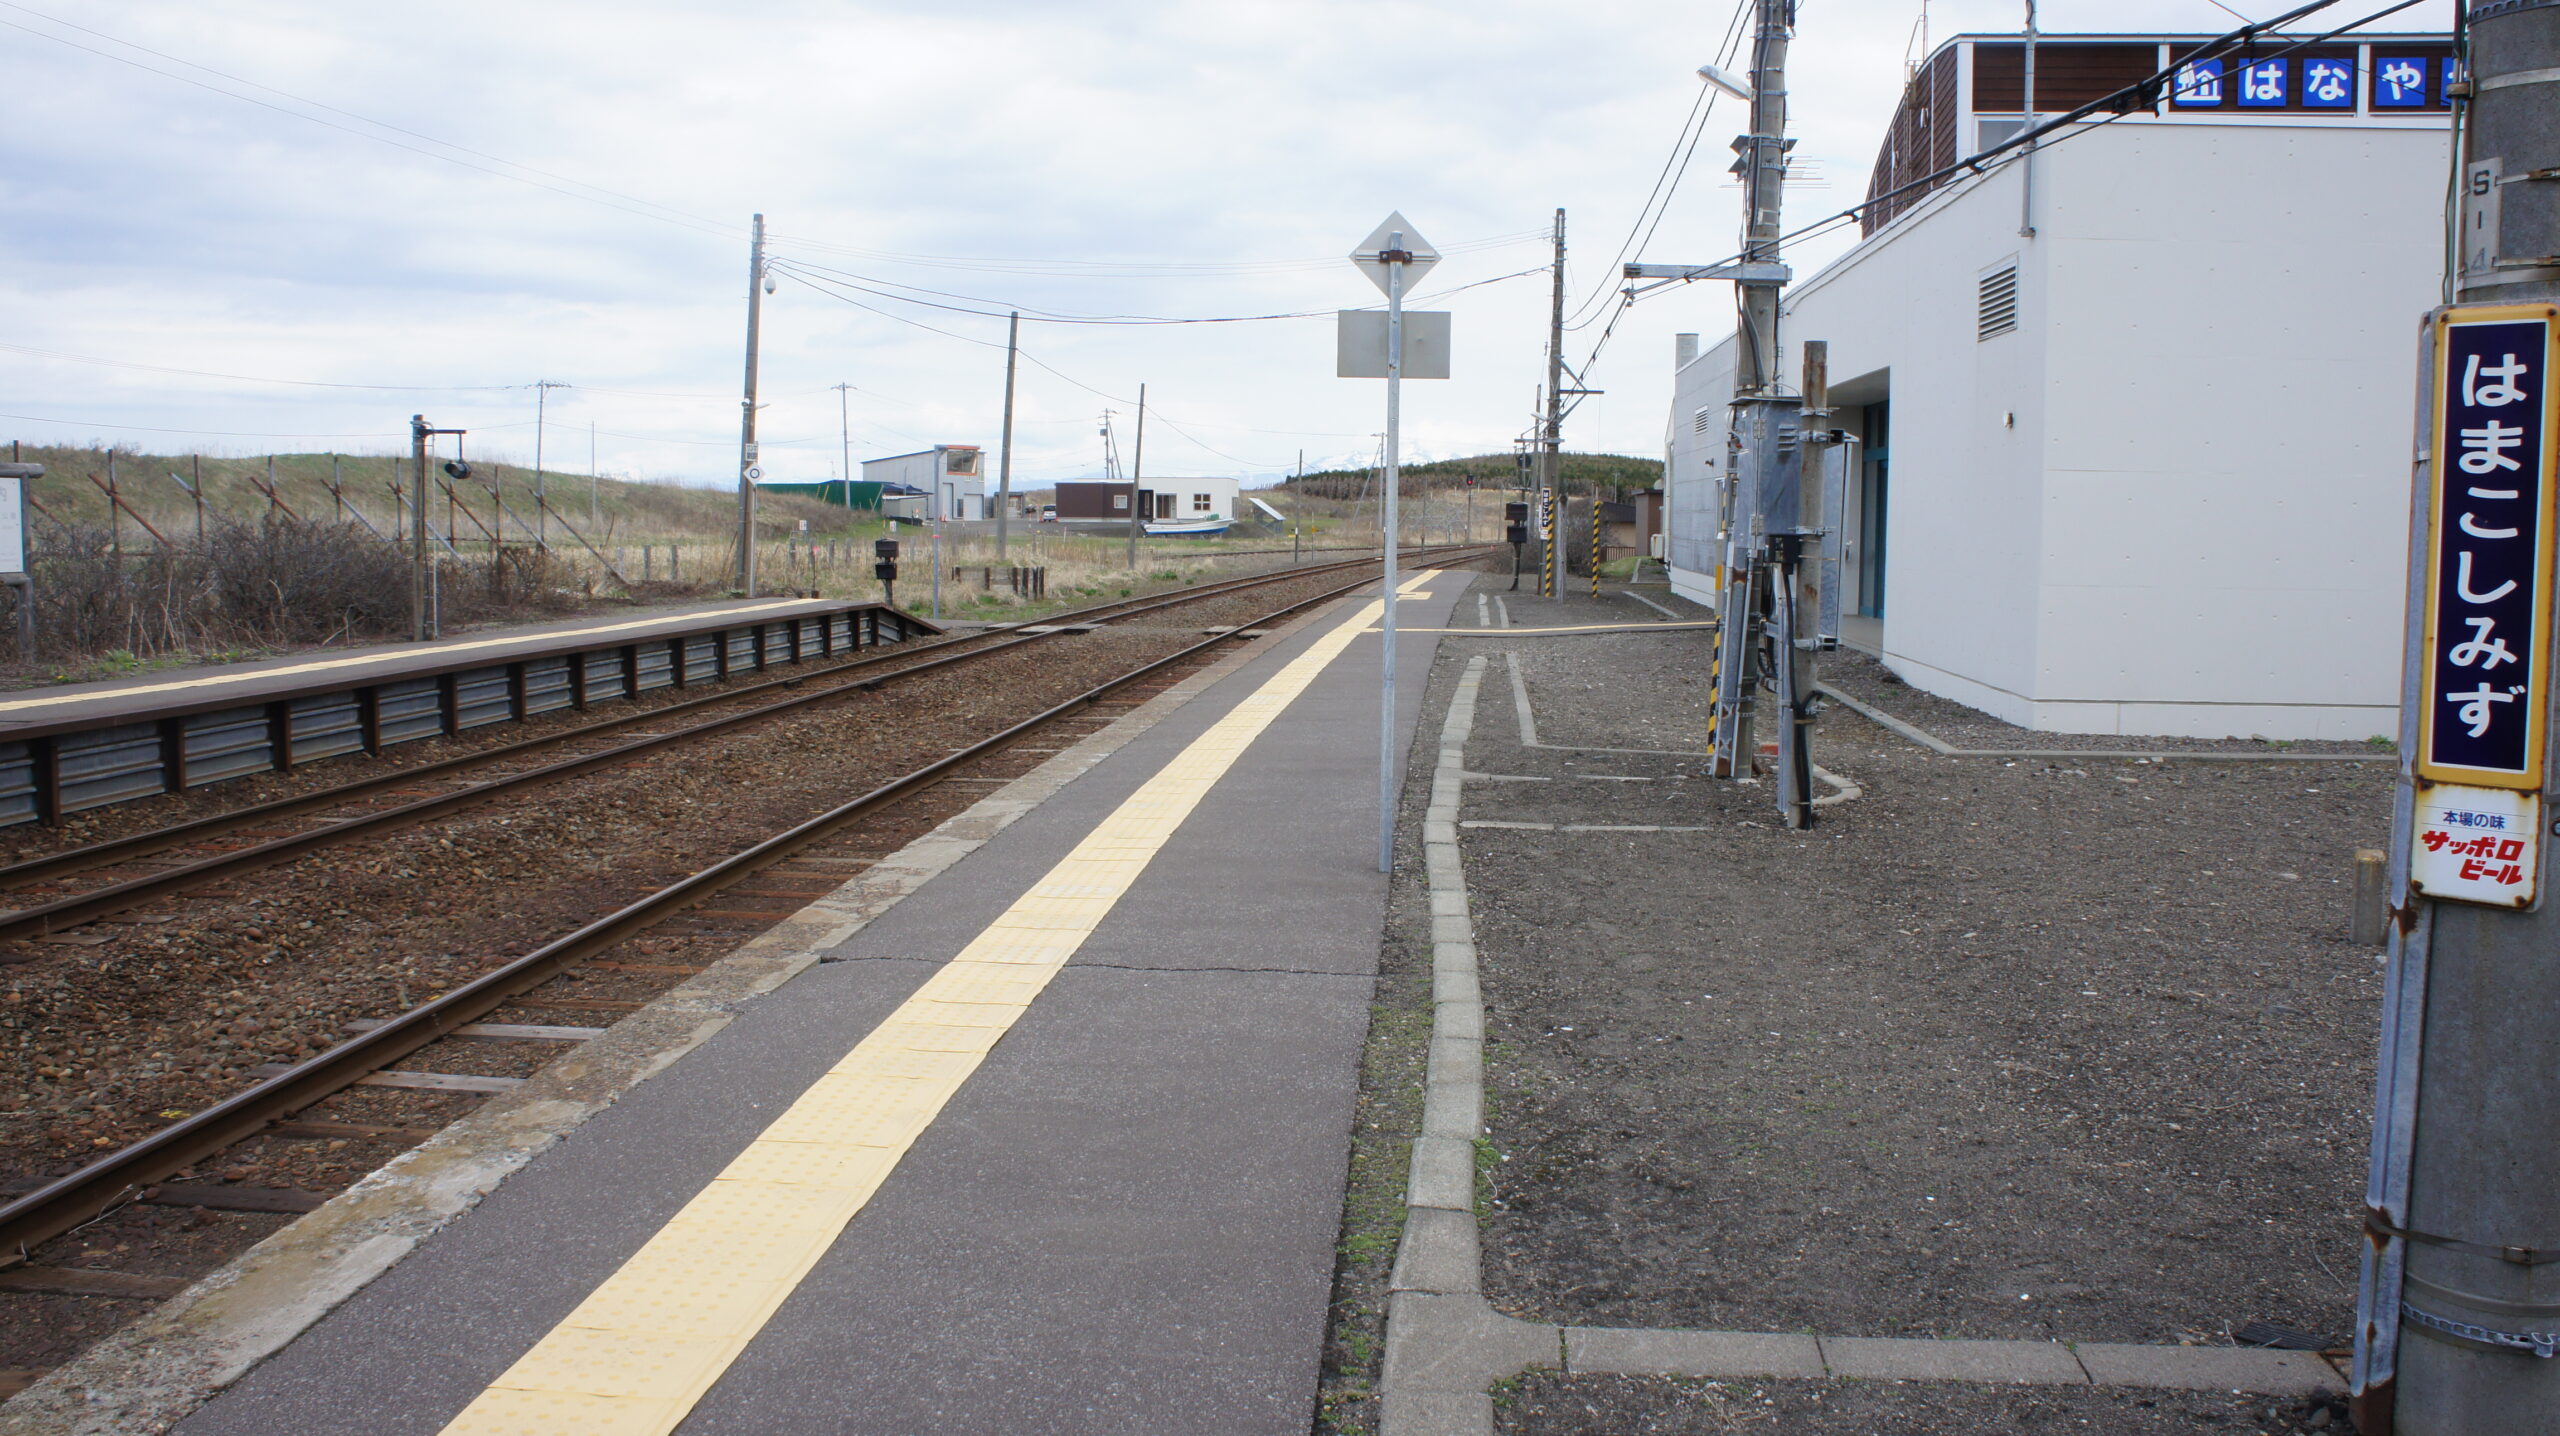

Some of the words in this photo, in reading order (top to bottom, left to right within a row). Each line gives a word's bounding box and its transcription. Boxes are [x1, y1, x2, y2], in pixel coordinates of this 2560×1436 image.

[2244, 62, 2468, 100] はなや
[2446, 353, 2527, 738] はまこしみず
[2443, 810, 2505, 830] 本場の味
[2421, 830, 2525, 862] サッポロ
[2459, 858, 2523, 885] ビール
